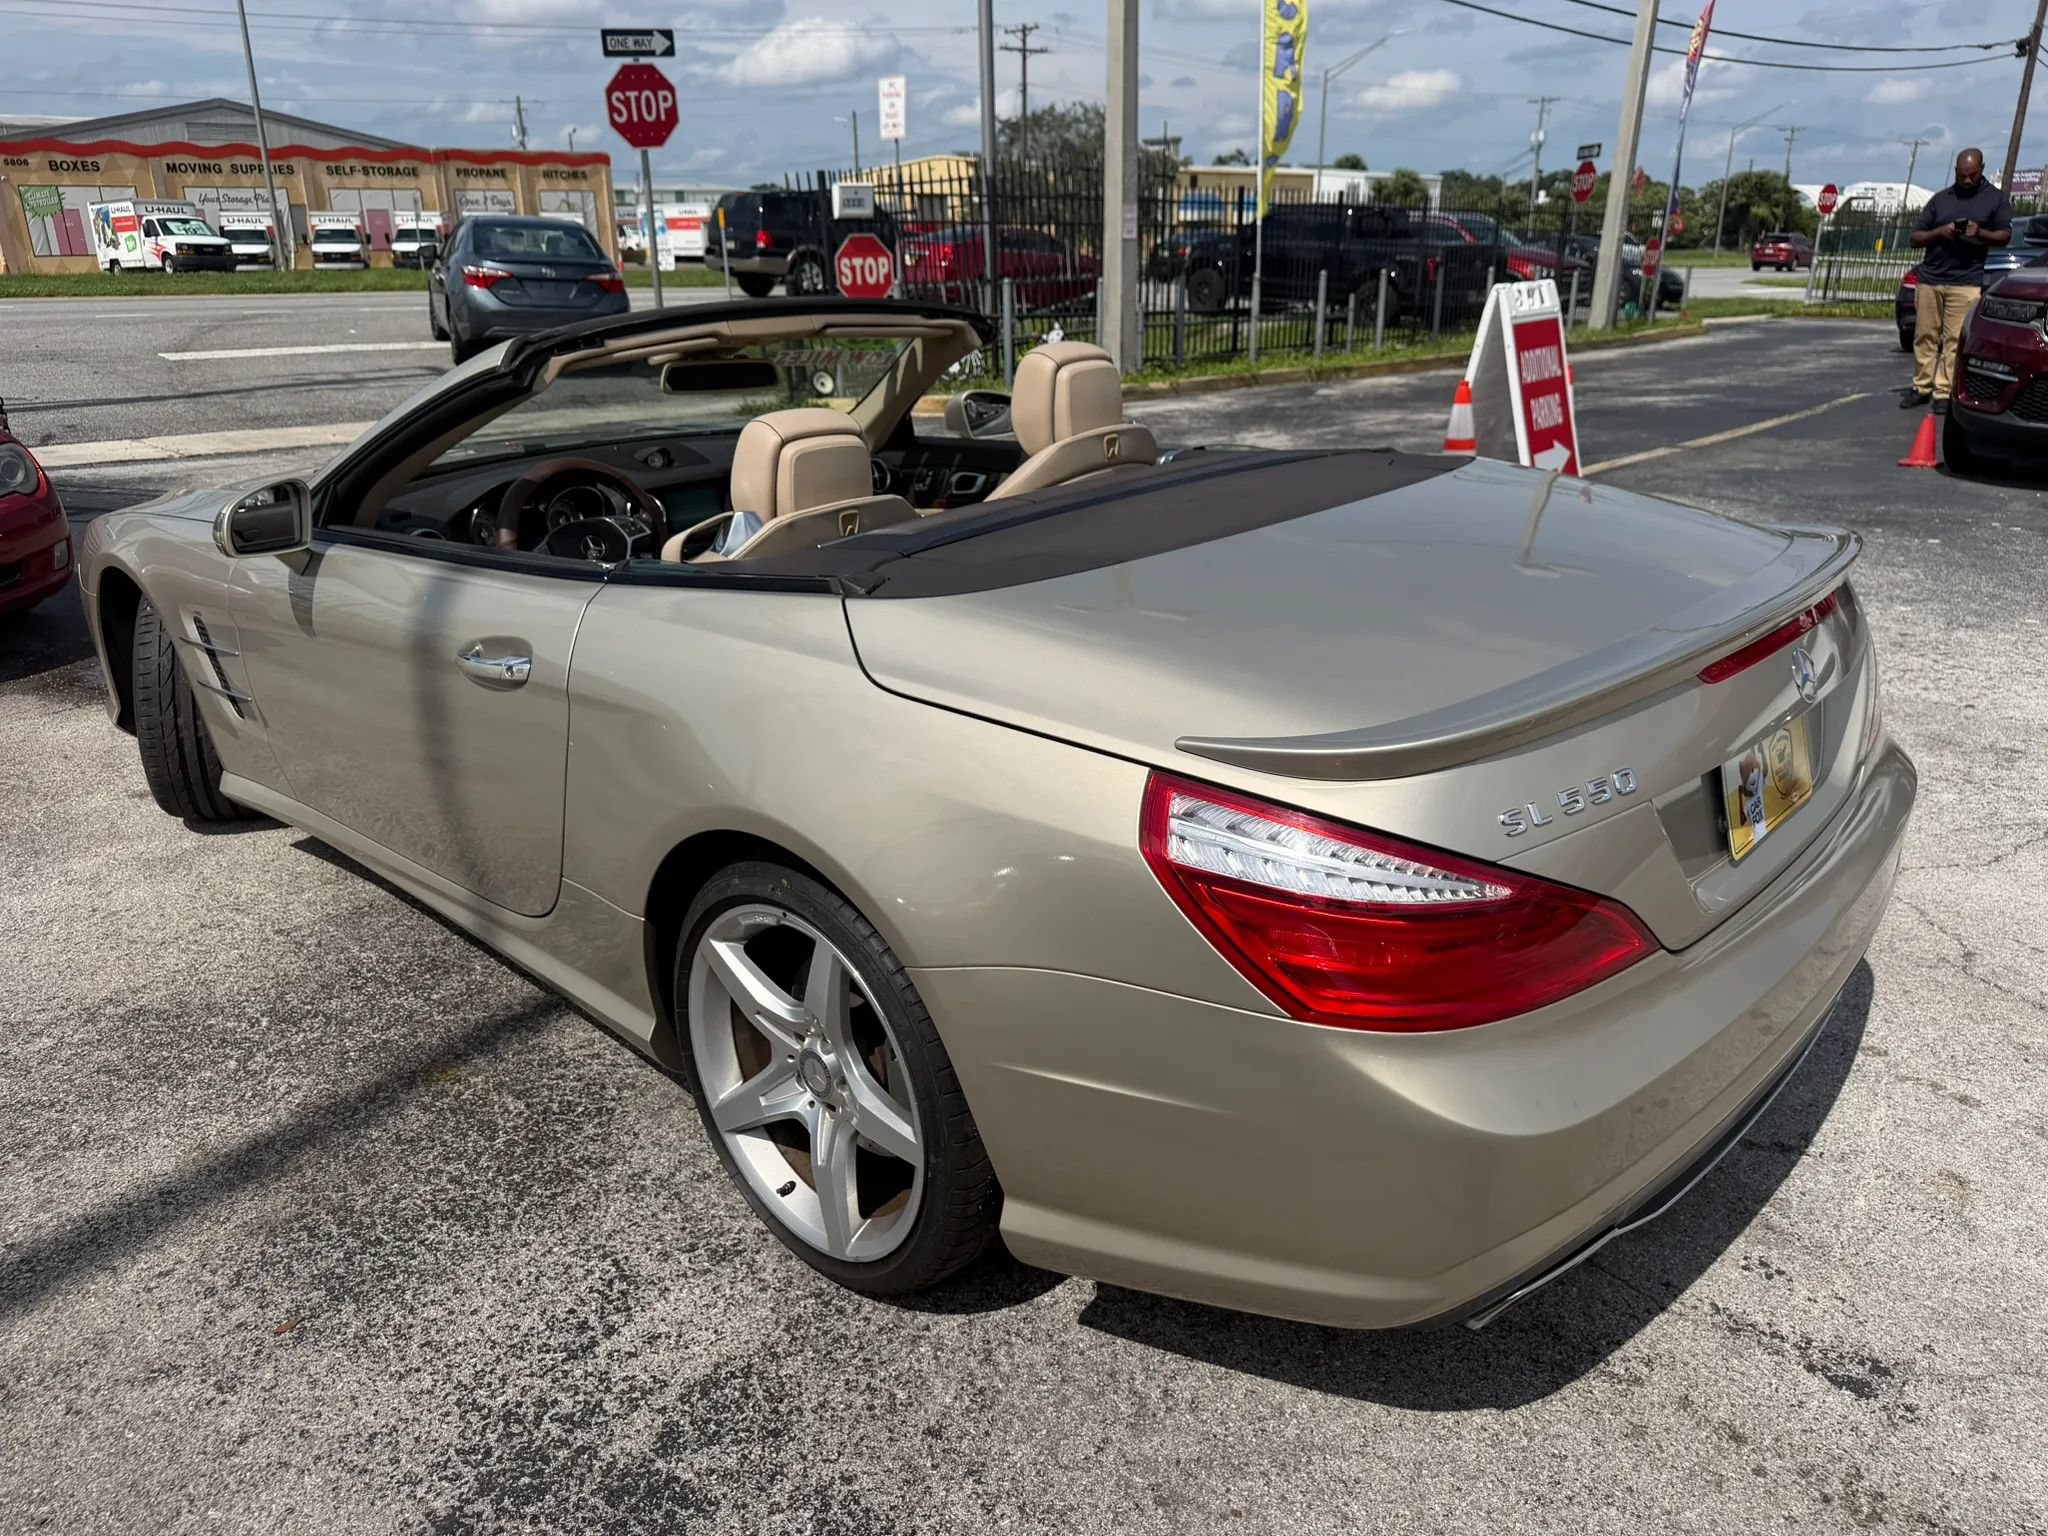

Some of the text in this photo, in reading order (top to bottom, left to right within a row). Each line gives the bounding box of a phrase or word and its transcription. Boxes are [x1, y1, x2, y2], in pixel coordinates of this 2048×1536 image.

[609, 37, 654, 49] ONE WAY
[611, 89, 673, 123] STOP
[3, 158, 29, 166] 5806
[48, 160, 101, 172] BOXES
[166, 162, 295, 175] MOVING SUPPIES
[326, 165, 419, 177] SELF-STORAGE
[456, 167, 507, 179] PROPANE
[542, 169, 588, 180] HITCHES
[1573, 171, 1596, 192] STOP
[198, 193, 220, 205] Your
[222, 193, 252, 204] Storage
[1820, 191, 1837, 206] STOP
[110, 205, 131, 214] U-HAUL
[145, 205, 188, 214] U-HAUL
[840, 256, 889, 286] STOP
[1520, 345, 1563, 384] ADDITIONAL
[1530, 392, 1563, 431] PARKING
[1498, 767, 1638, 838] SL 550
